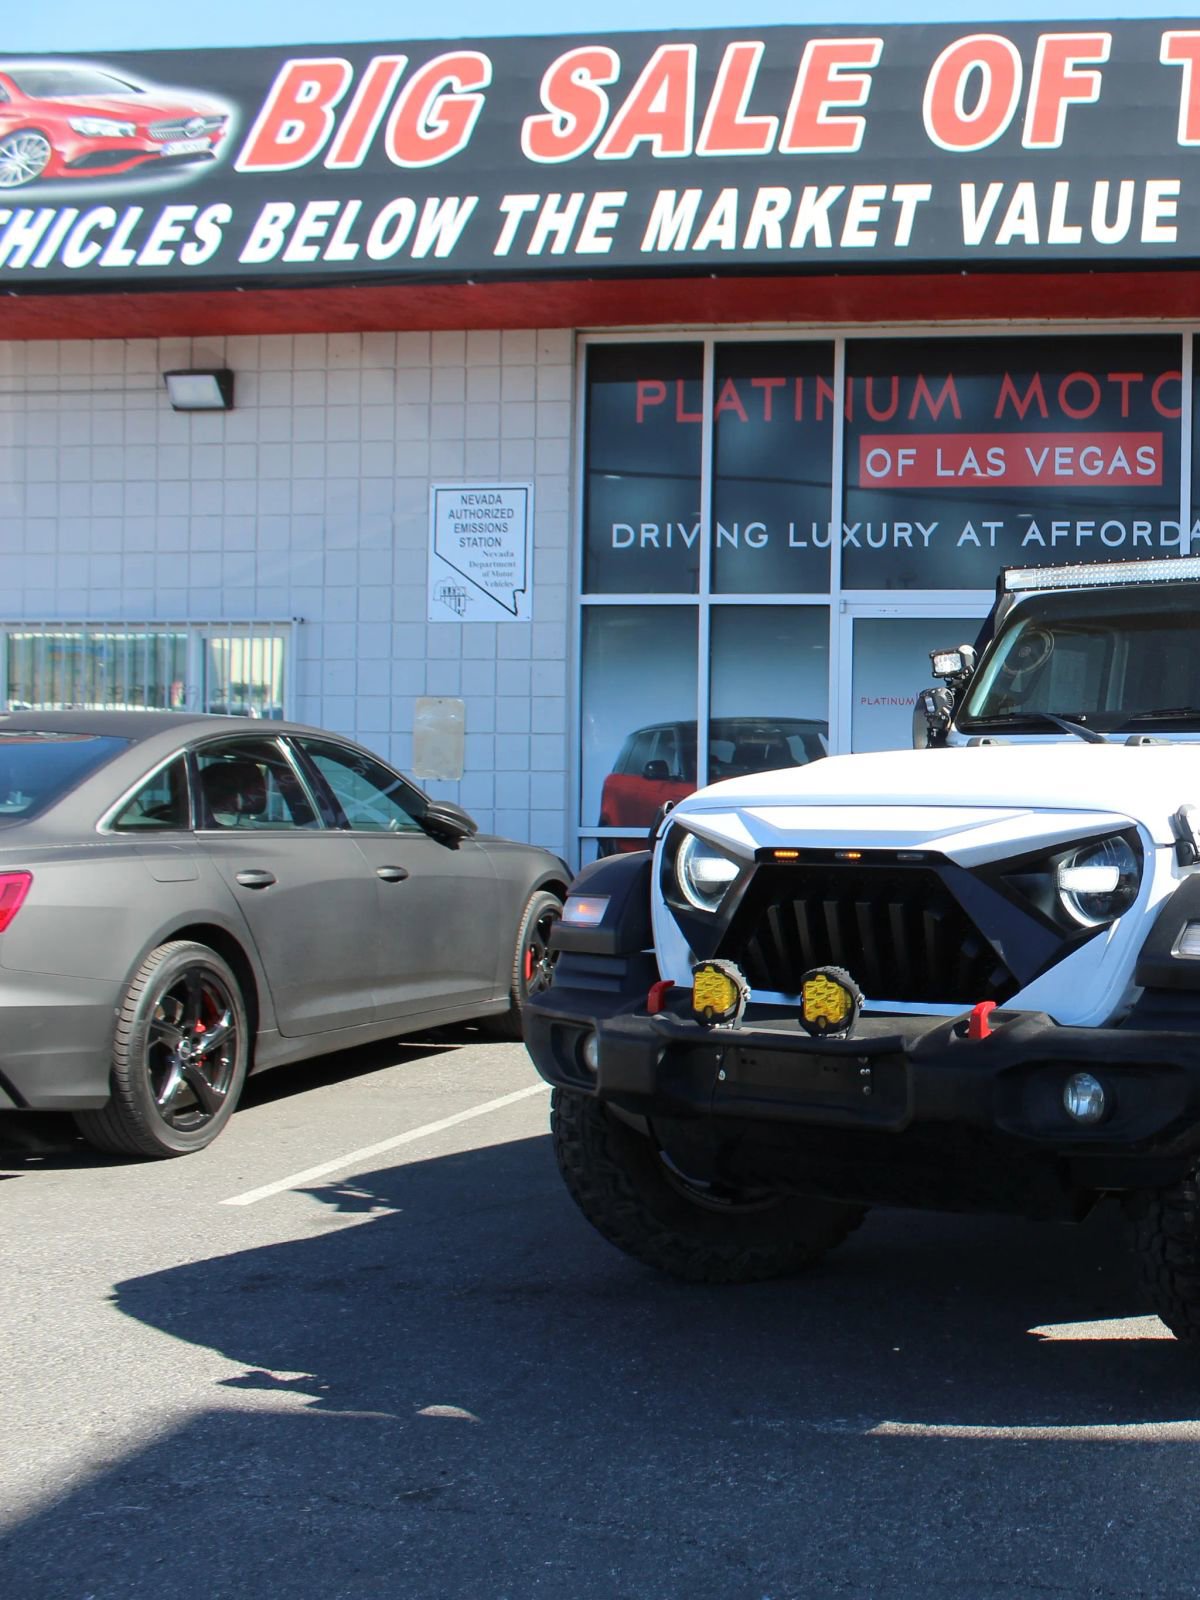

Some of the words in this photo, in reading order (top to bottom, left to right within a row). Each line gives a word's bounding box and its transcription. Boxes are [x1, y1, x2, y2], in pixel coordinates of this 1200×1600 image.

[234, 51, 493, 172] BIG
[520, 37, 884, 164] SALE
[923, 32, 1112, 152] OF
[238, 196, 479, 263] BELOW
[494, 191, 627, 256] THE
[641, 184, 932, 253] MARKET
[960, 179, 1181, 245] VALUE
[636, 373, 962, 423] PLATINUM
[866, 448, 917, 478] OF
[936, 447, 1007, 477] LAS
[1025, 445, 1156, 477] VEGAS
[460, 494, 503, 505] NEVADA
[448, 508, 515, 519] AUTHORIZED
[454, 522, 509, 534] EMISSIONS
[611, 522, 769, 549] DRIVNG
[788, 522, 939, 549] LUXURY
[956, 520, 1005, 547] AT
[459, 537, 502, 548] STATION
[482, 550, 515, 558] Nevada
[469, 560, 516, 570] Department
[484, 580, 514, 588] Vehicles
[860, 697, 915, 706] PLATINUM
